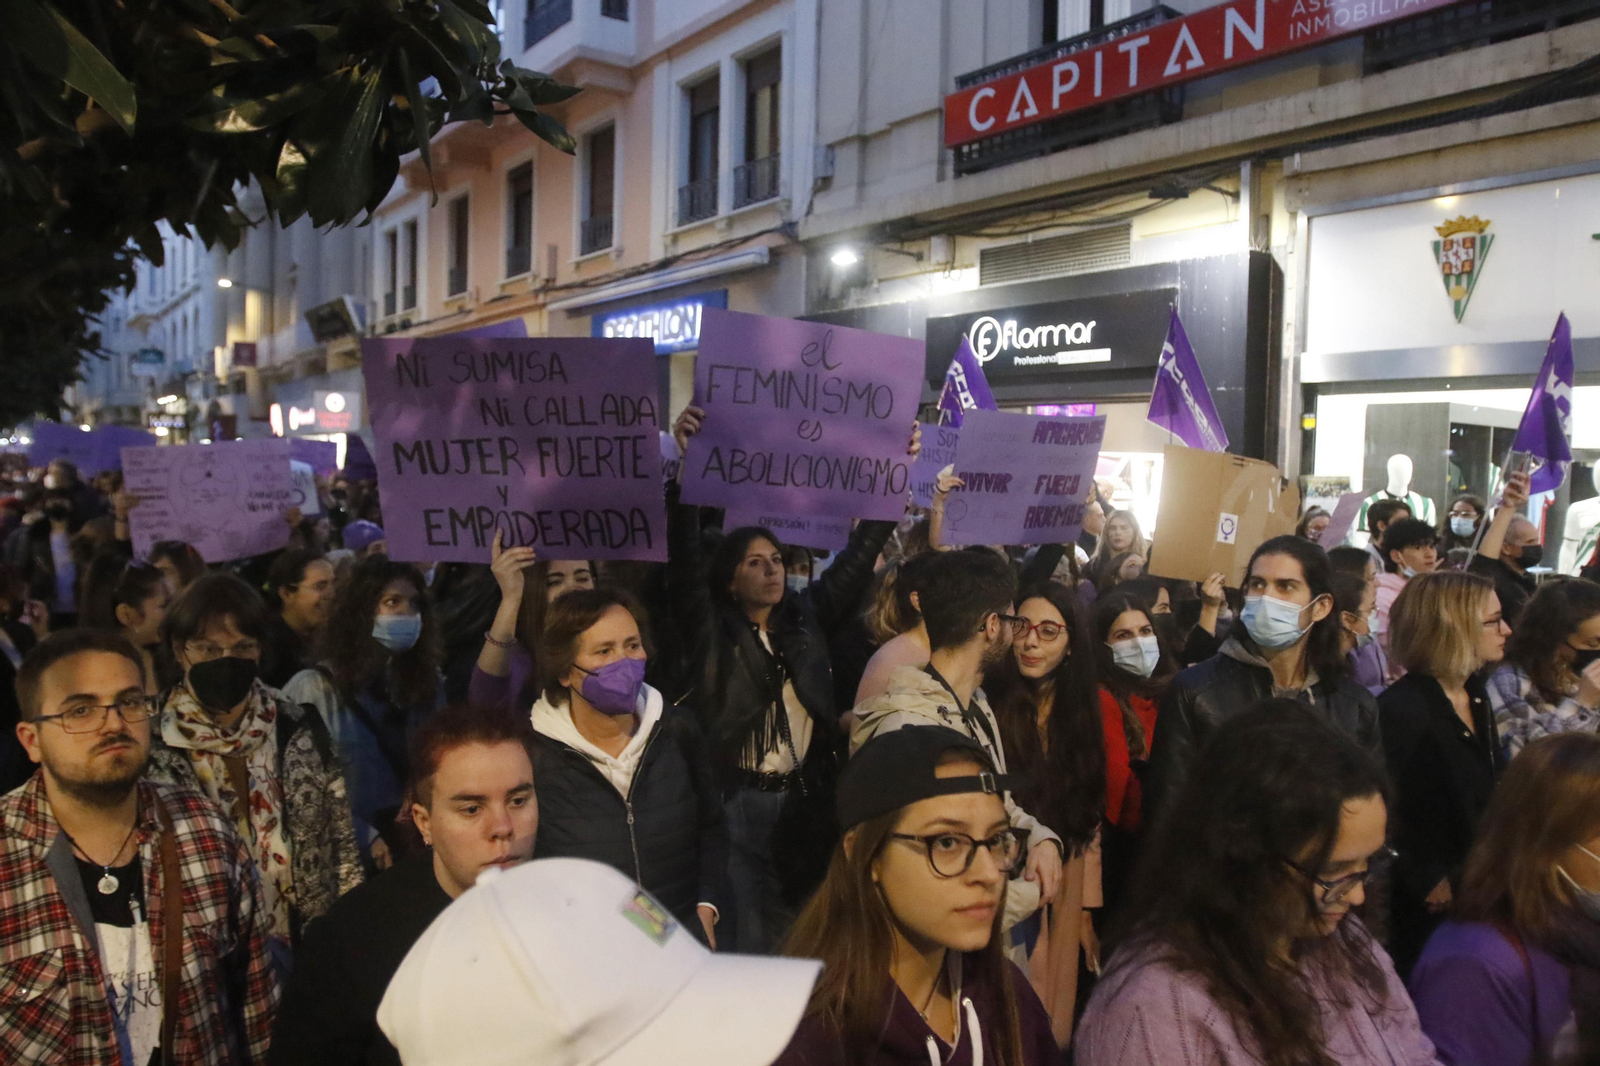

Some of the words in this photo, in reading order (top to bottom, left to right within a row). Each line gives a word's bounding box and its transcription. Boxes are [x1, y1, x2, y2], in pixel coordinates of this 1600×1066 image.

[1289, 0, 1427, 41] INMOBILI
[968, 0, 1265, 131] CAPITAN
[800, 329, 843, 371] el
[1002, 320, 1096, 350] flormar
[449, 351, 569, 384] SUMISA
[1013, 352, 1058, 366] Professional
[523, 393, 657, 427] CALLADA
[706, 364, 894, 419] FEMINISMO
[797, 419, 823, 442] es
[392, 437, 526, 476] MUJER
[536, 435, 650, 479] FUERTE
[701, 446, 909, 497] ABOLICIONISMO
[423, 506, 653, 550] EMPODERADA
